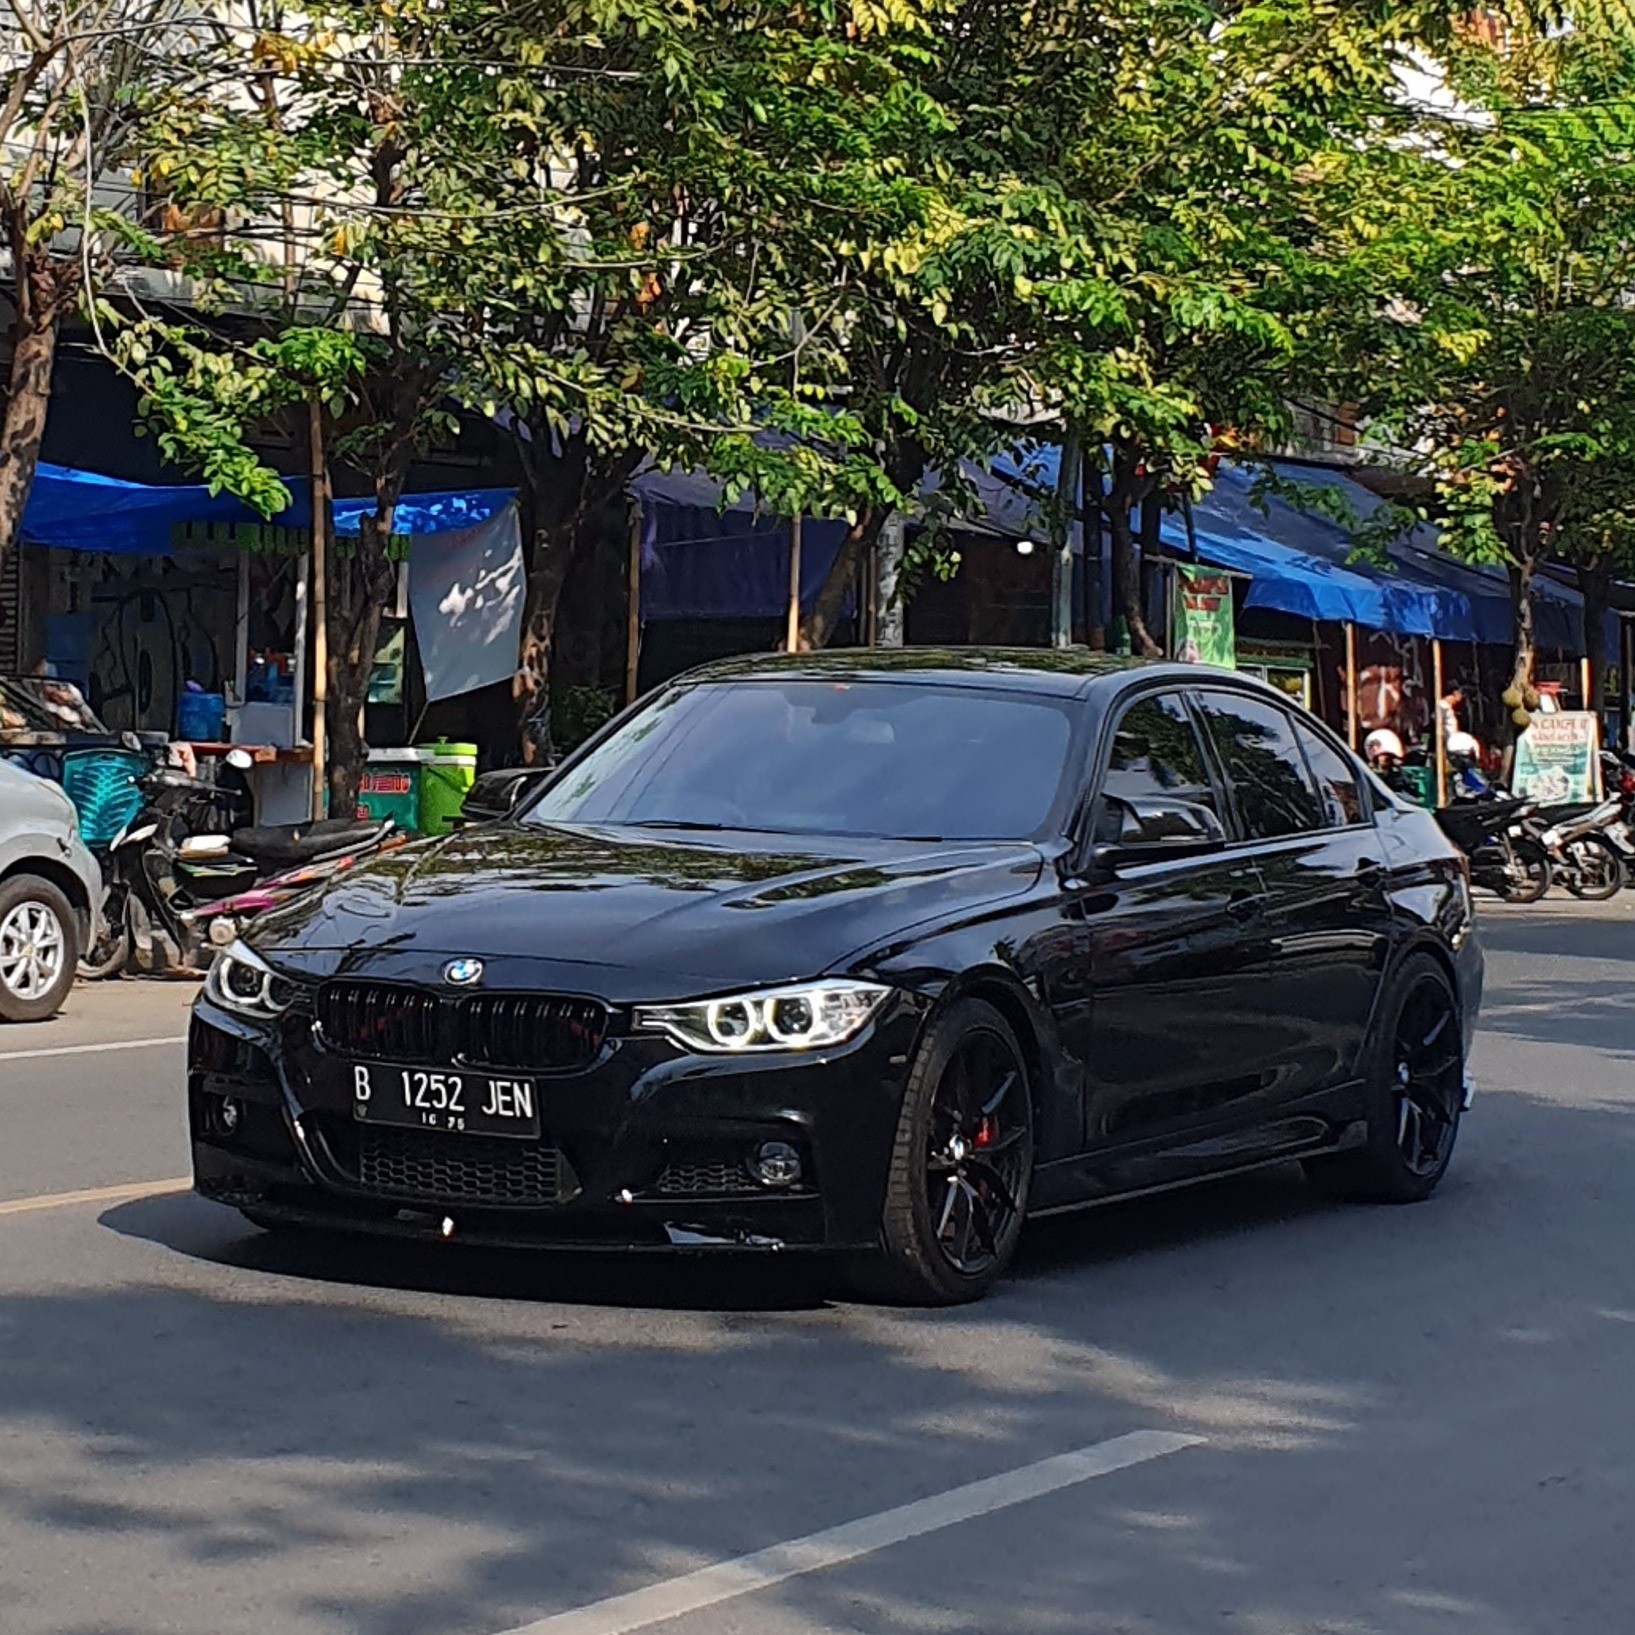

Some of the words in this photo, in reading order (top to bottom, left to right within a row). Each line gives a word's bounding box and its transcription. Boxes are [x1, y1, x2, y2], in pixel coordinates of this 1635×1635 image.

[354, 1065, 371, 1101] B
[401, 1071, 465, 1112] 1252
[481, 1080, 533, 1118] JEN
